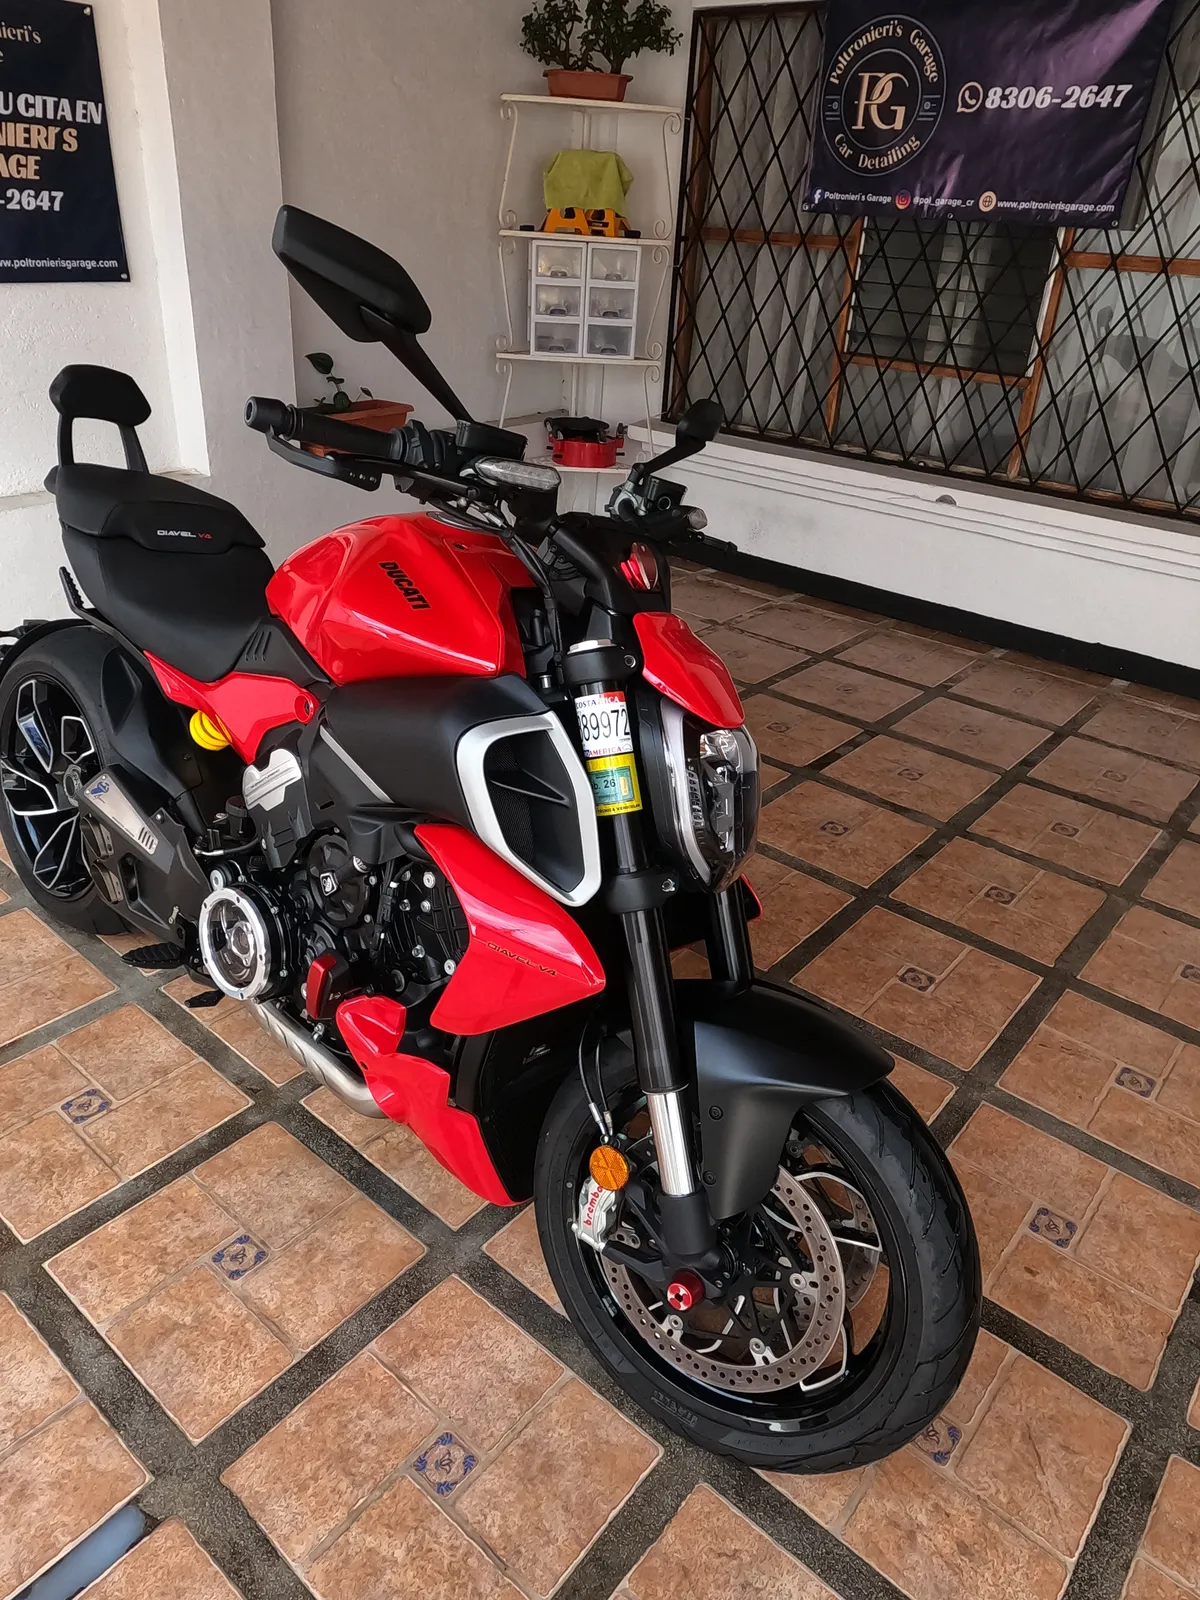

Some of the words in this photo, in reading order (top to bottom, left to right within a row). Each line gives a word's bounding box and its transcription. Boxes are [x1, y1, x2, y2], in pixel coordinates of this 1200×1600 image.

[0, 21, 42, 44] ieri's
[830, 20, 904, 85] Poltronieri's
[909, 29, 939, 84] Garage
[17, 93, 73, 122] CITA
[75, 99, 103, 125] EN
[851, 72, 910, 131] PG
[985, 84, 1133, 109] 8306-2647
[834, 133, 854, 159] Car
[858, 134, 921, 170] Detailing
[0, 188, 64, 211] -2647
[866, 193, 892, 204] Garage
[913, 195, 975, 208] @pol_garage_cr
[997, 200, 1115, 214] www.poltronierisgarage.com
[156, 529, 197, 538] DIAVEL
[197, 532, 213, 540] V4
[377, 560, 432, 611] DUCATI
[575, 699, 597, 710] COSTA
[603, 778, 616, 789] 26
[487, 942, 537, 969] DIAVEL
[538, 964, 558, 977] V4
[583, 1185, 604, 1227] brembo
[651, 1388, 700, 1429] PIRELLI
